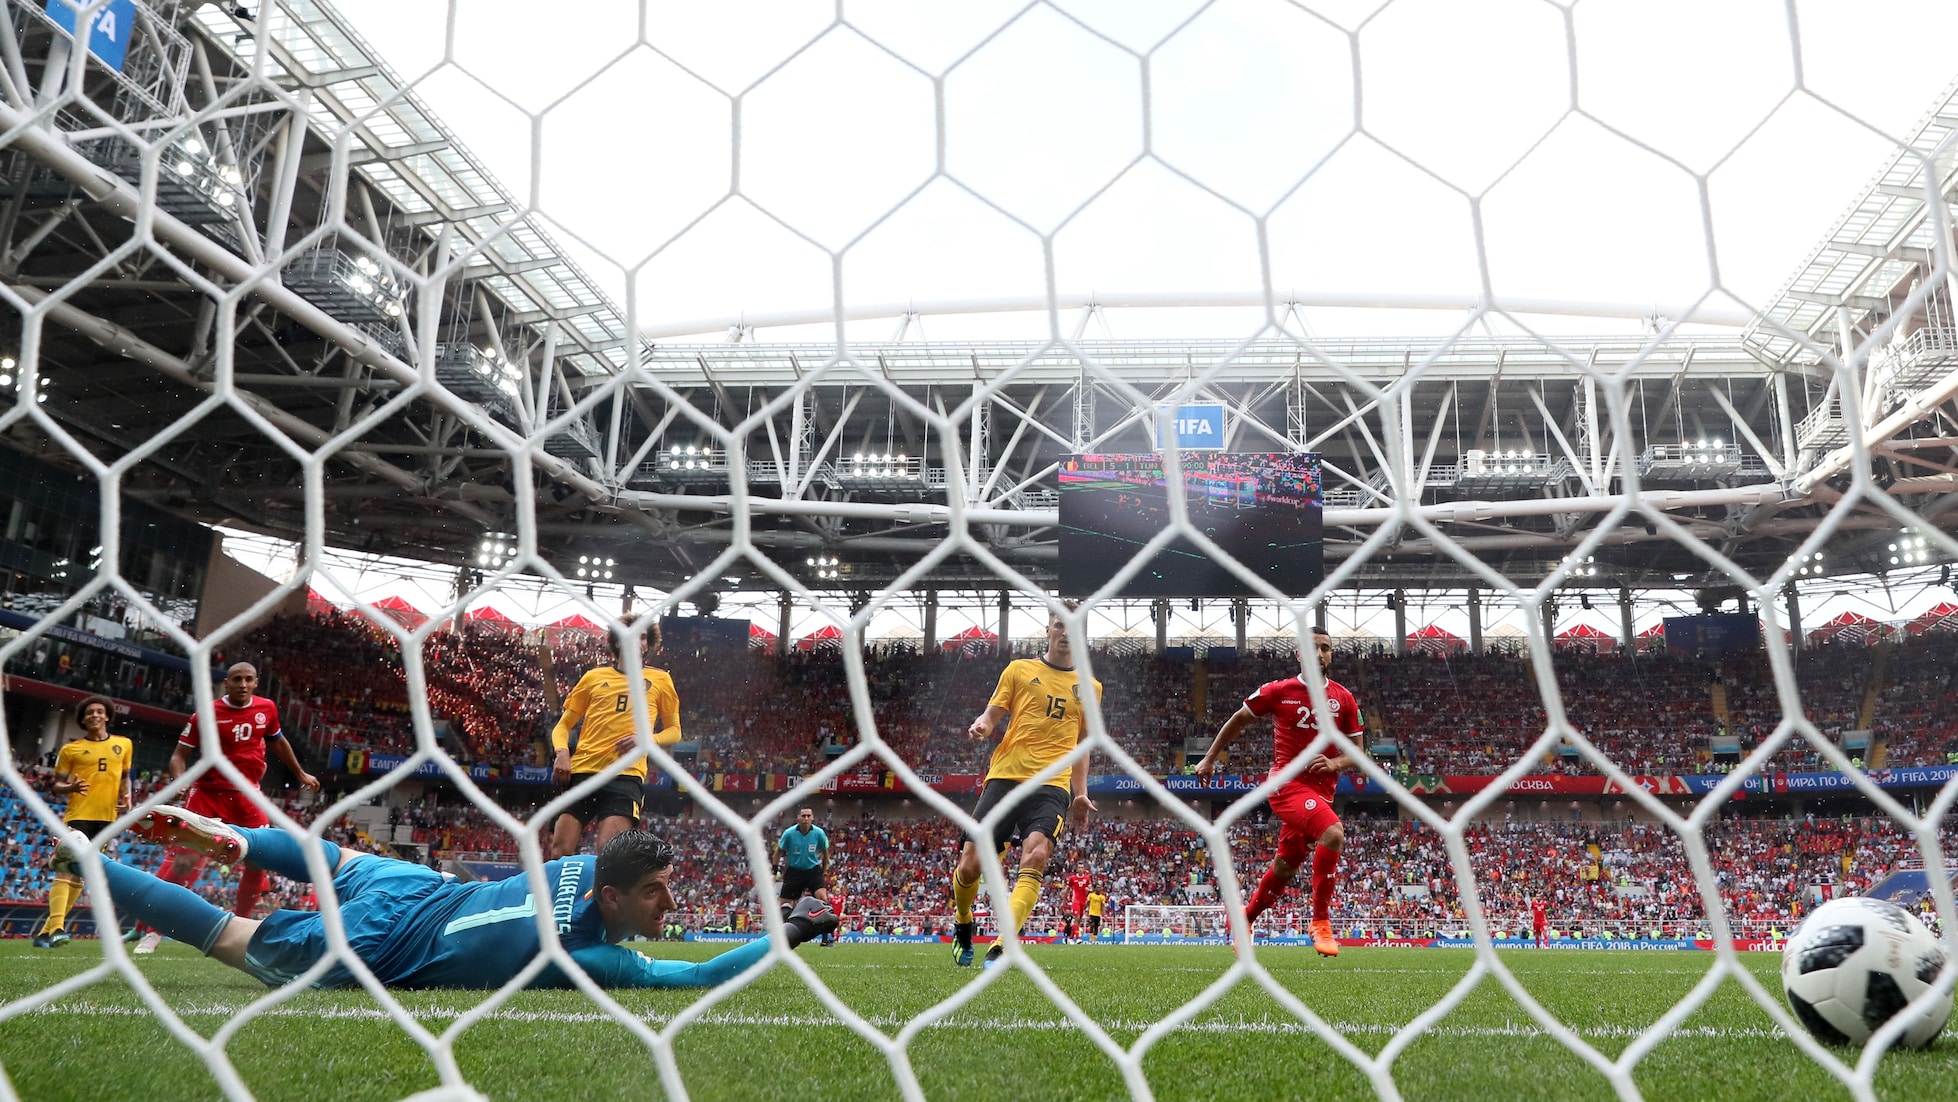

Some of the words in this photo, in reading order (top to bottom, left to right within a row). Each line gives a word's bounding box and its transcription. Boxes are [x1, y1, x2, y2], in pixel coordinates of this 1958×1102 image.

[1083, 462, 1100, 470] BEL
[1110, 462, 1116, 470] 5
[1125, 462, 1131, 470] 1
[1140, 462, 1159, 470] TUN
[1182, 462, 1204, 470] 90:00
[616, 694, 629, 712] 8
[1045, 693, 1067, 720] 15
[231, 722, 252, 742] 10
[98, 758, 107, 772] 6
[369, 758, 434, 774] ЕМПАТ
[1819, 776, 1837, 787] ПО
[1902, 772, 1928, 782] FIFA
[1930, 769, 1956, 781] 2018
[1116, 780, 1141, 790] 2018
[1167, 780, 1204, 790] WORL
[1234, 780, 1260, 790] RUS
[1052, 814, 1065, 841] 1
[552, 861, 585, 936] COURTOIS
[444, 893, 537, 937] 1
[1539, 941, 1580, 949] фтболу
[1581, 941, 1604, 949] FIFA
[1605, 942, 1631, 950] 2018
